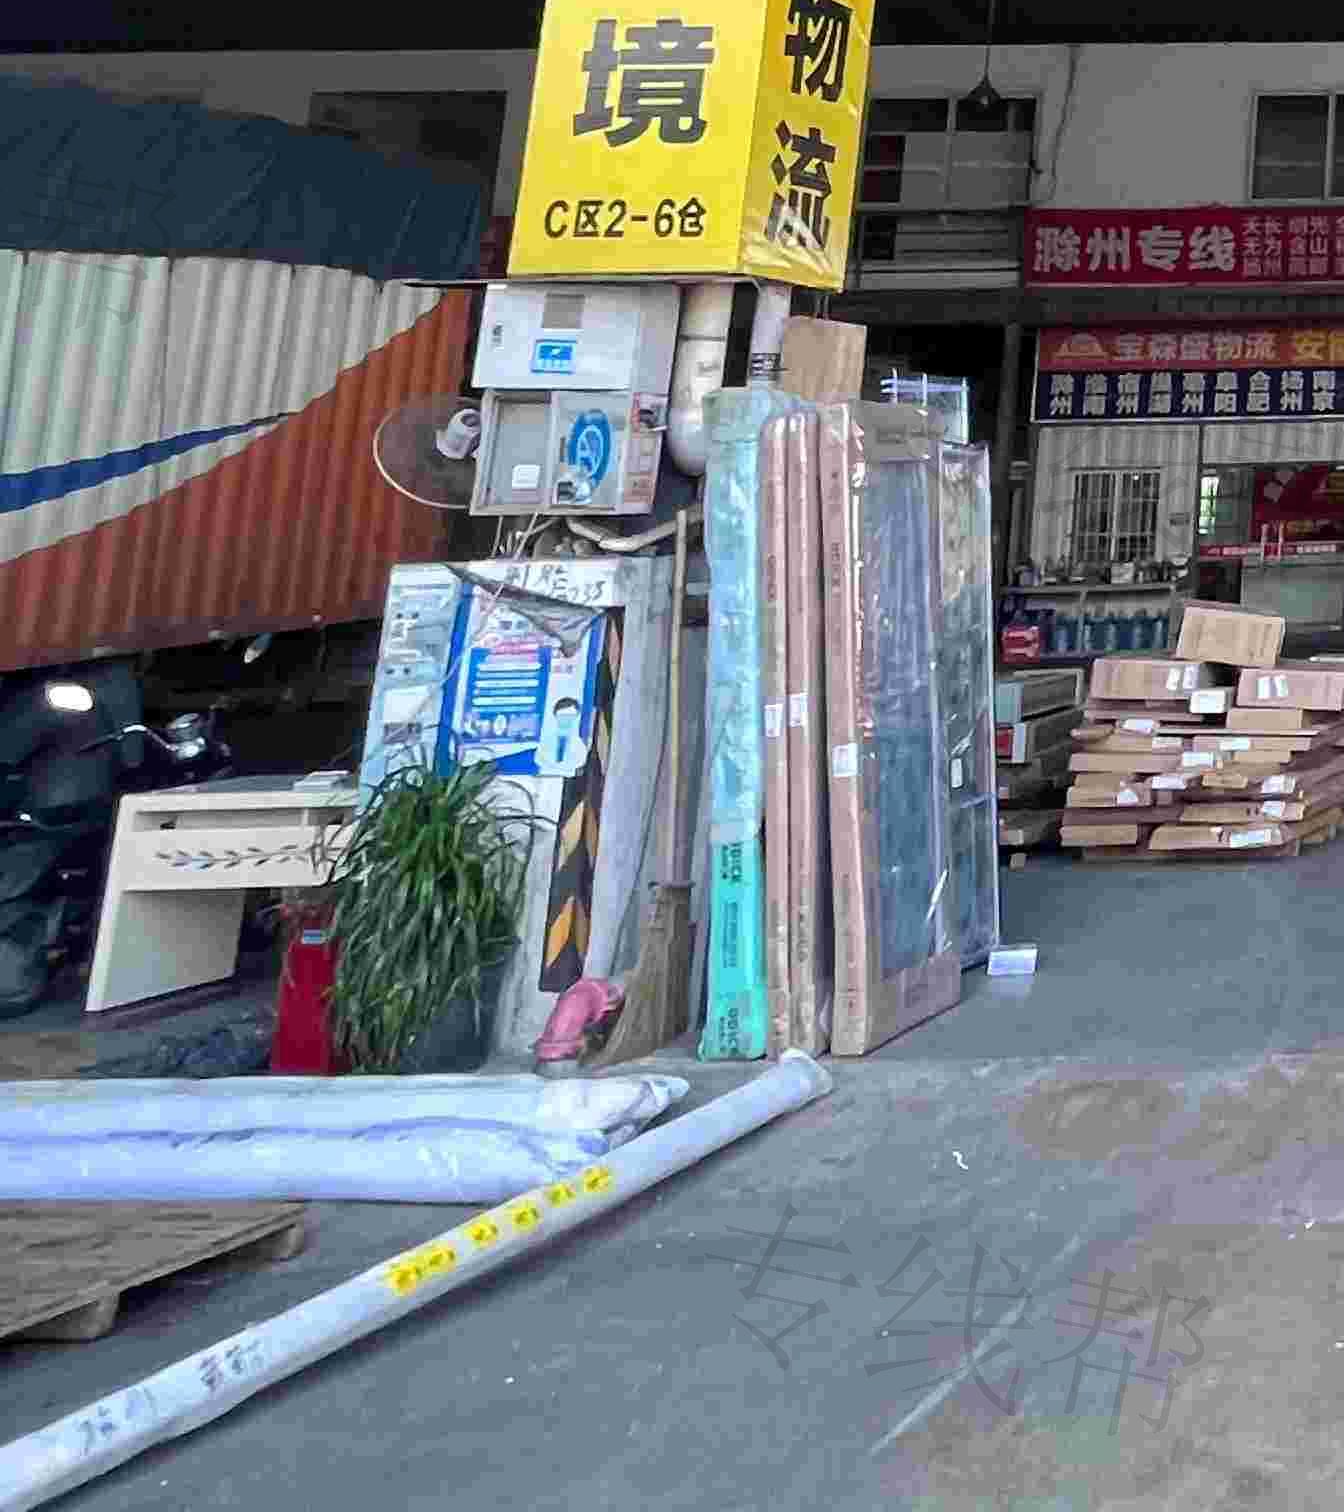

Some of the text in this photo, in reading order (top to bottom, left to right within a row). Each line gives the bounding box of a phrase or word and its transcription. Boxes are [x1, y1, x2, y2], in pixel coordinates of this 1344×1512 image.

[544, 197, 706, 237] C区2-6仓
[1033, 225, 1236, 272] 滁州专线
